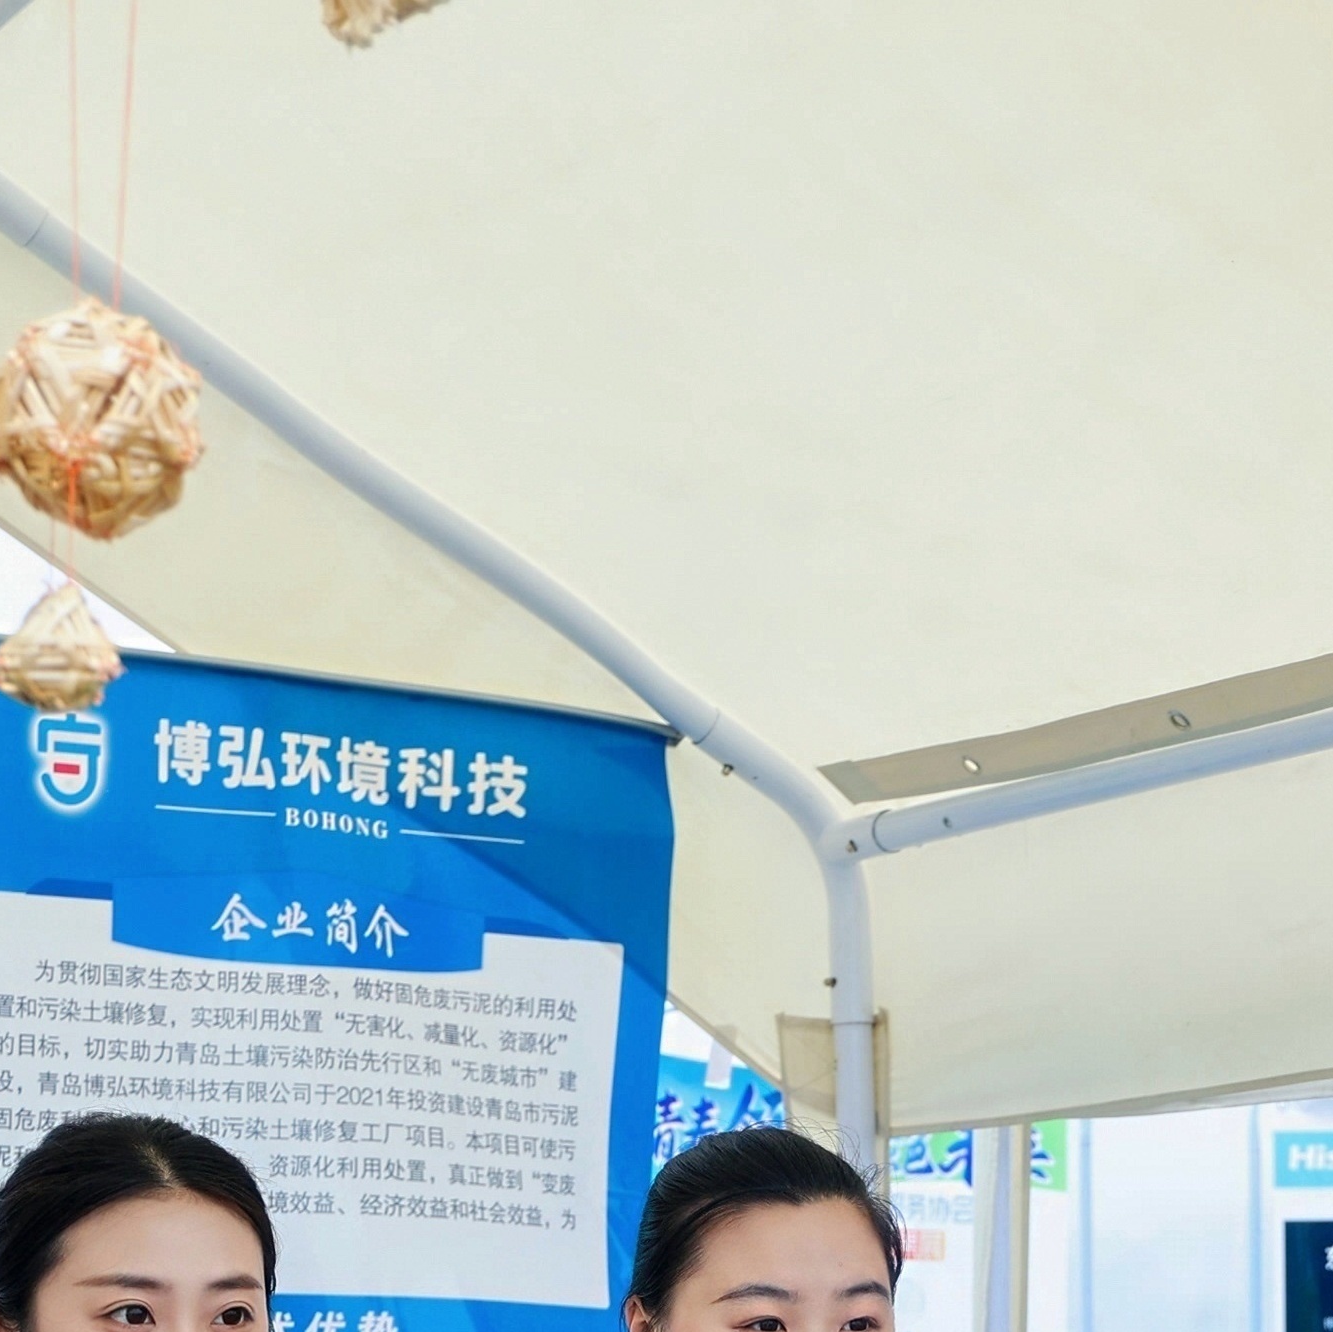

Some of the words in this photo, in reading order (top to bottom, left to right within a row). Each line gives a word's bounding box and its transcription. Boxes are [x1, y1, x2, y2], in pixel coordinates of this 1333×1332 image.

[154, 718, 528, 819] 博弘环境科技
[285, 807, 389, 839] BOHONG
[211, 893, 410, 958] 企业简介
